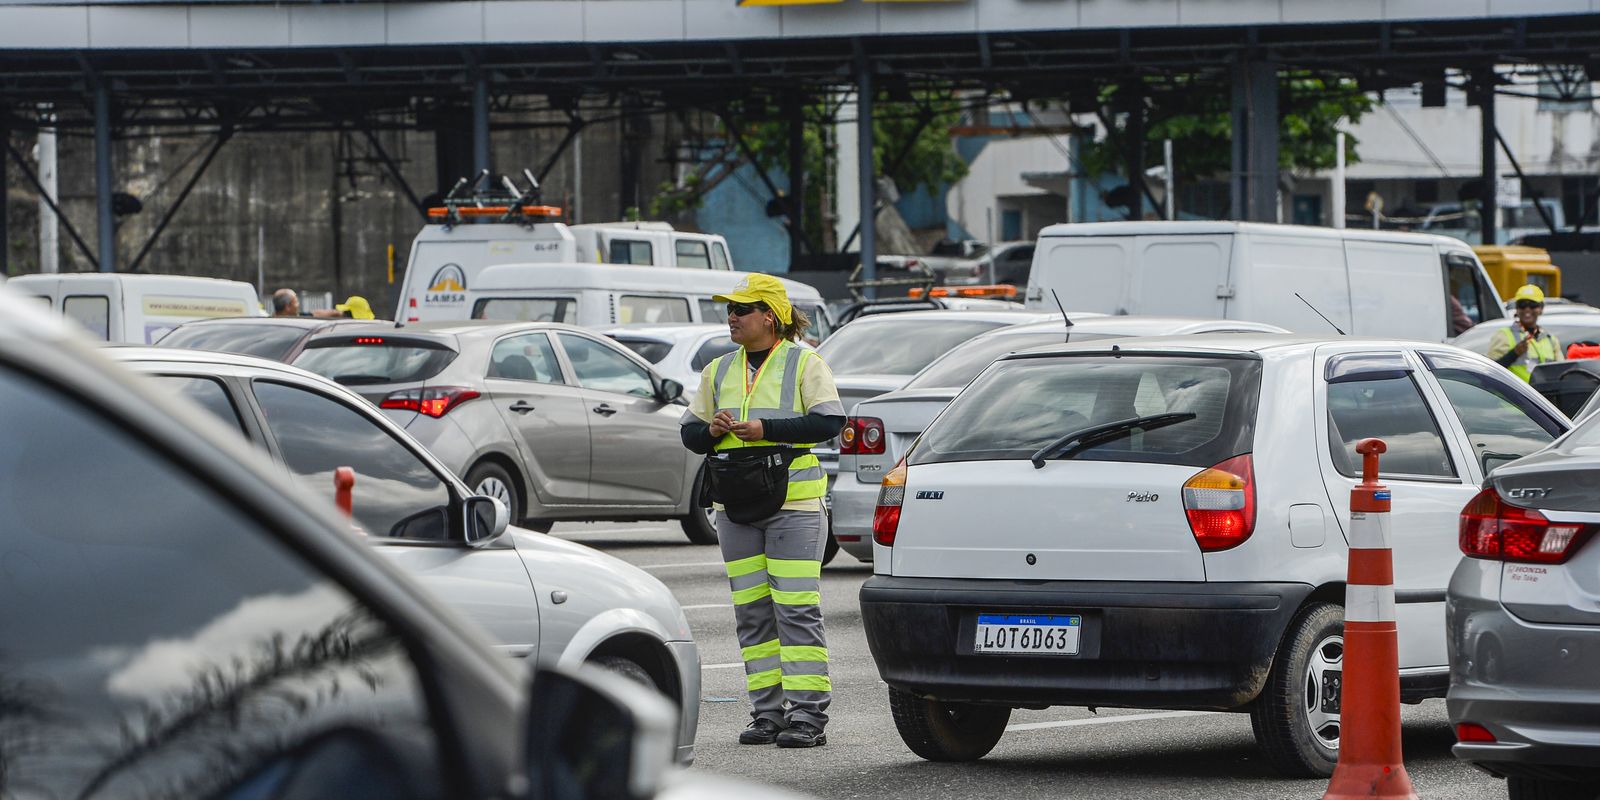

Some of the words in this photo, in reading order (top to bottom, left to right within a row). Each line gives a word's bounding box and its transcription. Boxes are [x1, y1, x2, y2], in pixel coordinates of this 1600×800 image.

[425, 294, 465, 302] LAMSA
[916, 491, 944, 499] FIAT
[1126, 491, 1159, 502] Palio
[1508, 487, 1552, 498] CITY
[1515, 566, 1547, 574] HONDA
[984, 627, 1068, 649] LOT6D63
